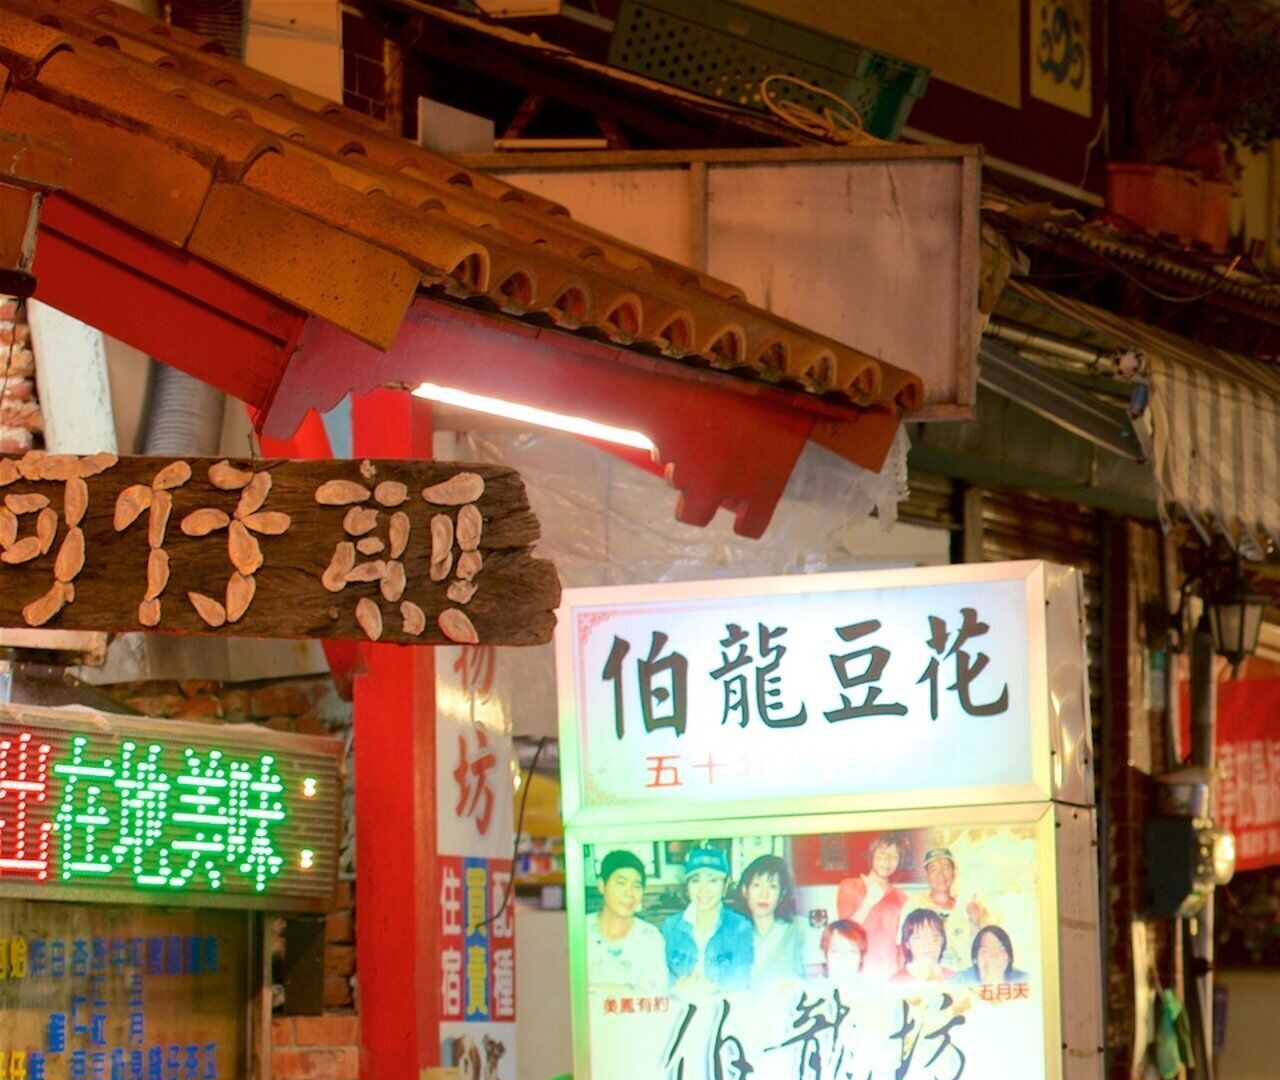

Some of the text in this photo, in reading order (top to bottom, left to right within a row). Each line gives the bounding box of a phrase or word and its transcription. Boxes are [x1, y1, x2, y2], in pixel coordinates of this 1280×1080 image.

[602, 608, 1010, 740] 伯龍豆花
[0, 733, 285, 891] 出在地美味
[978, 982, 1030, 1001] 五月天
